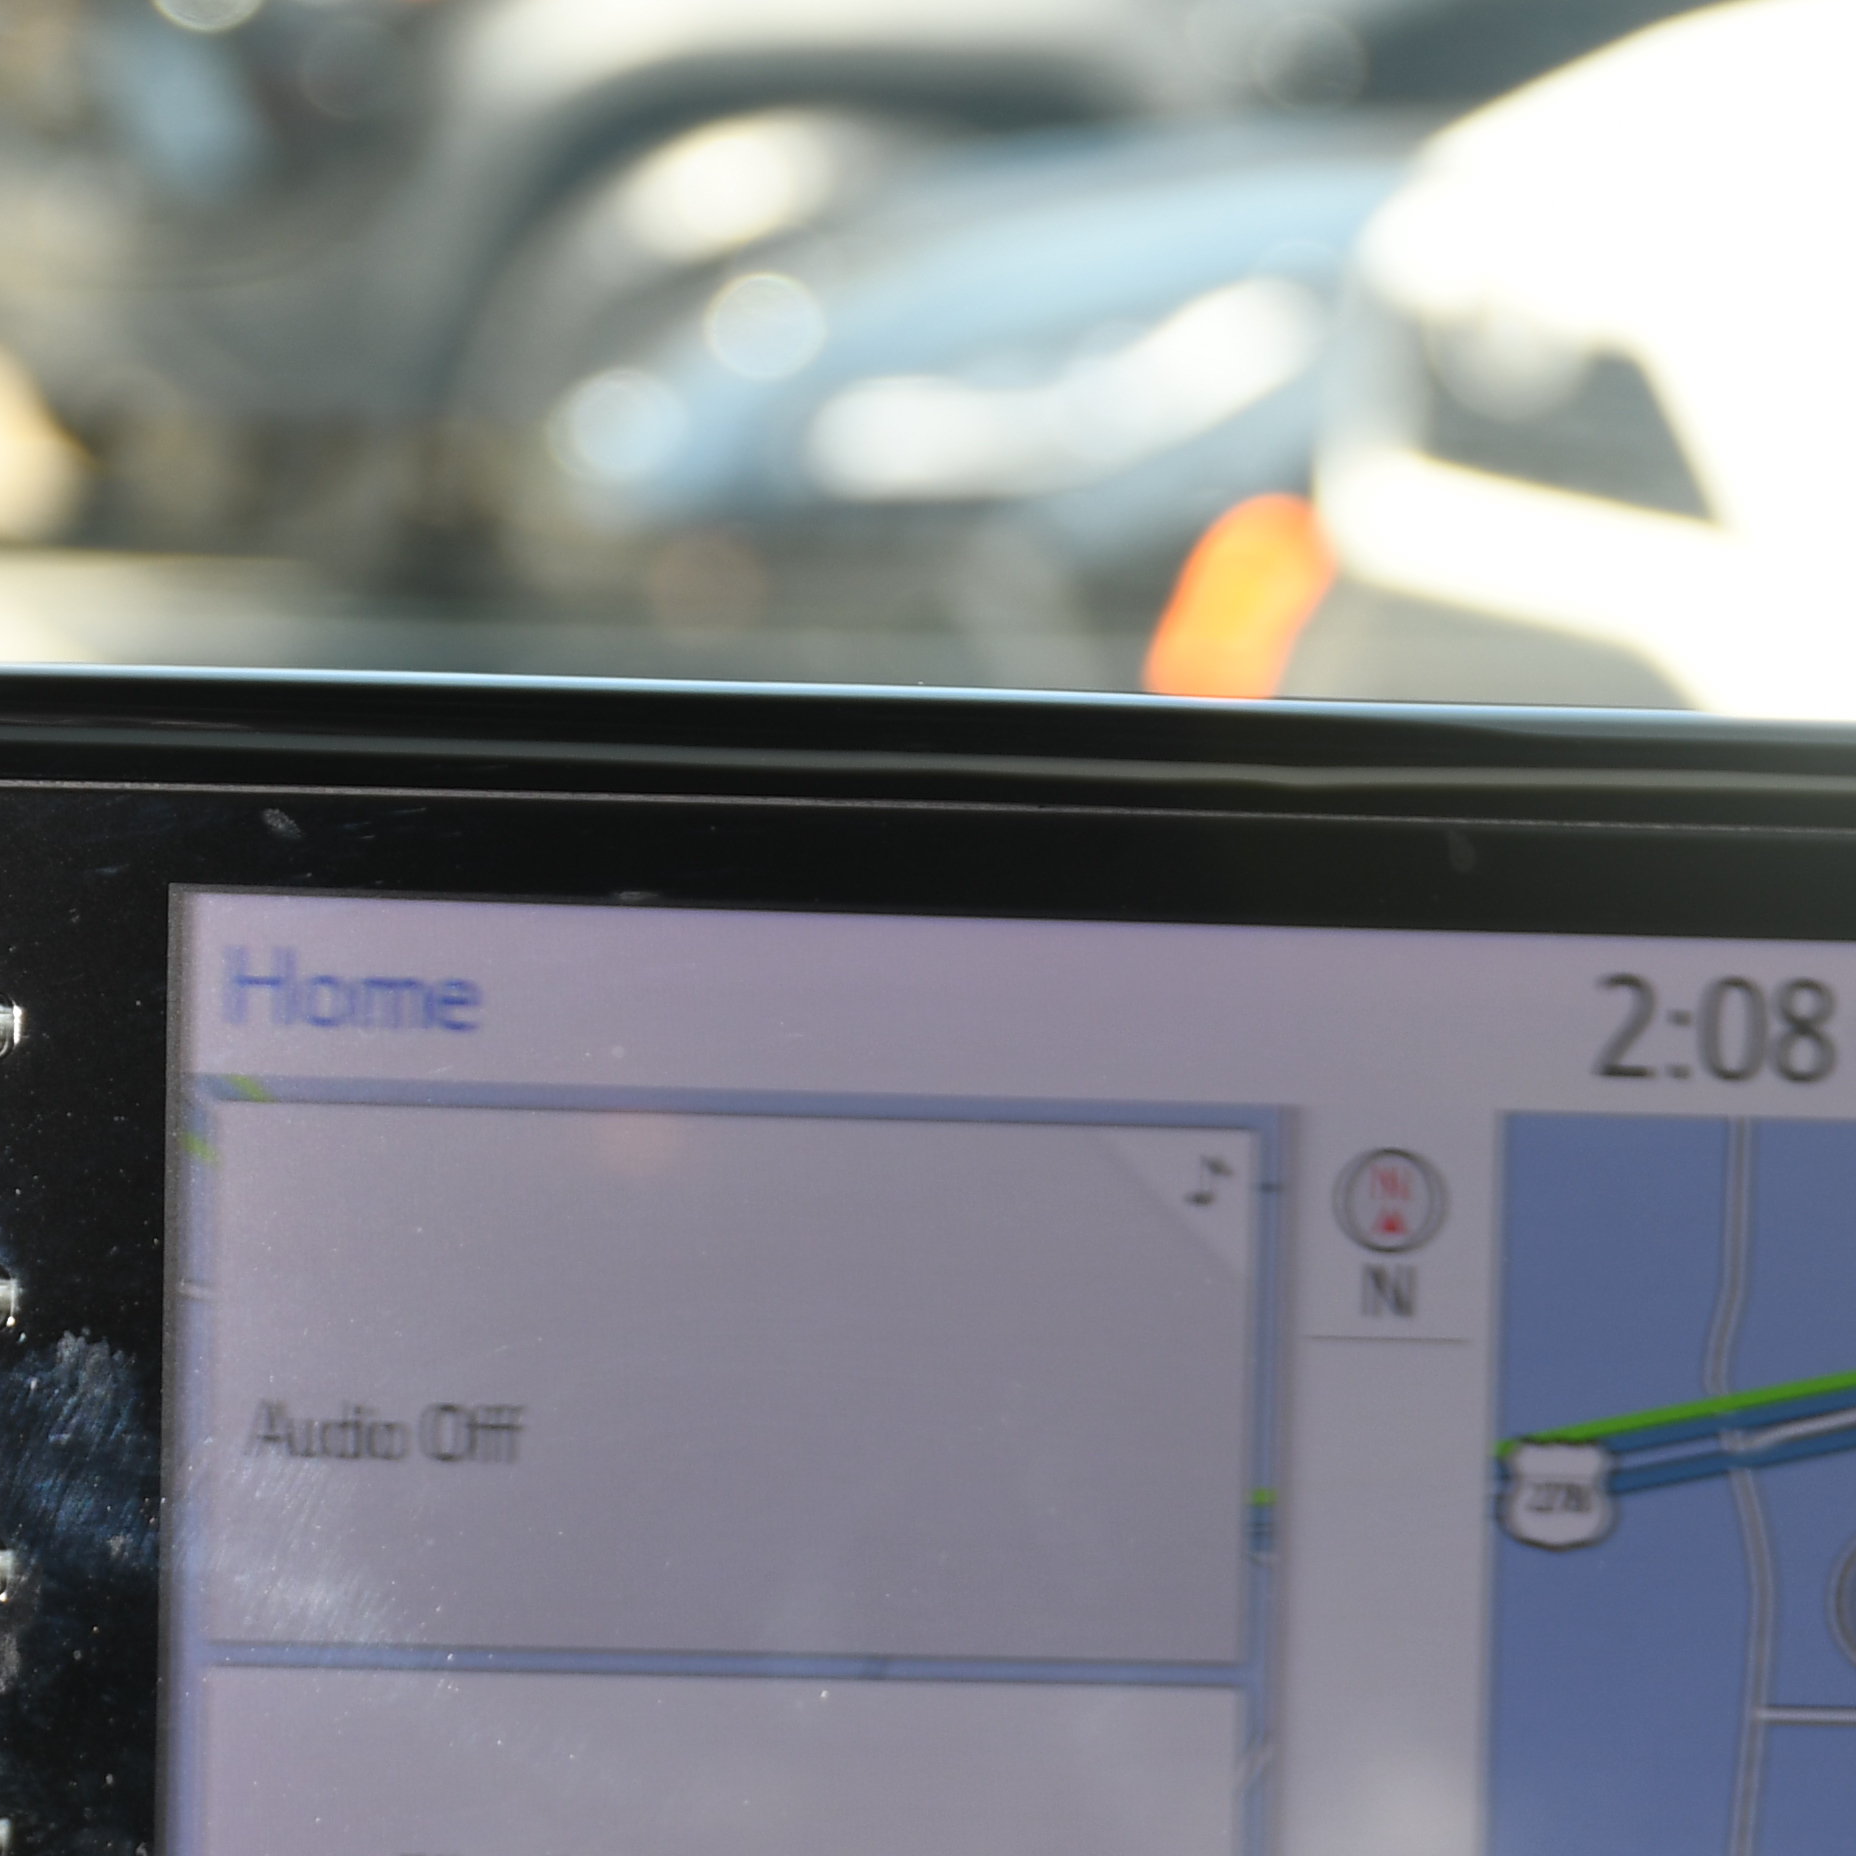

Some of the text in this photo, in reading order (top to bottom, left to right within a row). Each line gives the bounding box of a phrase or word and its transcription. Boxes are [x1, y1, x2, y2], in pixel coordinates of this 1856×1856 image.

[220, 944, 484, 1032] Home
[1591, 973, 1839, 1083] 2:08
[242, 1401, 527, 1465] Audio Off
